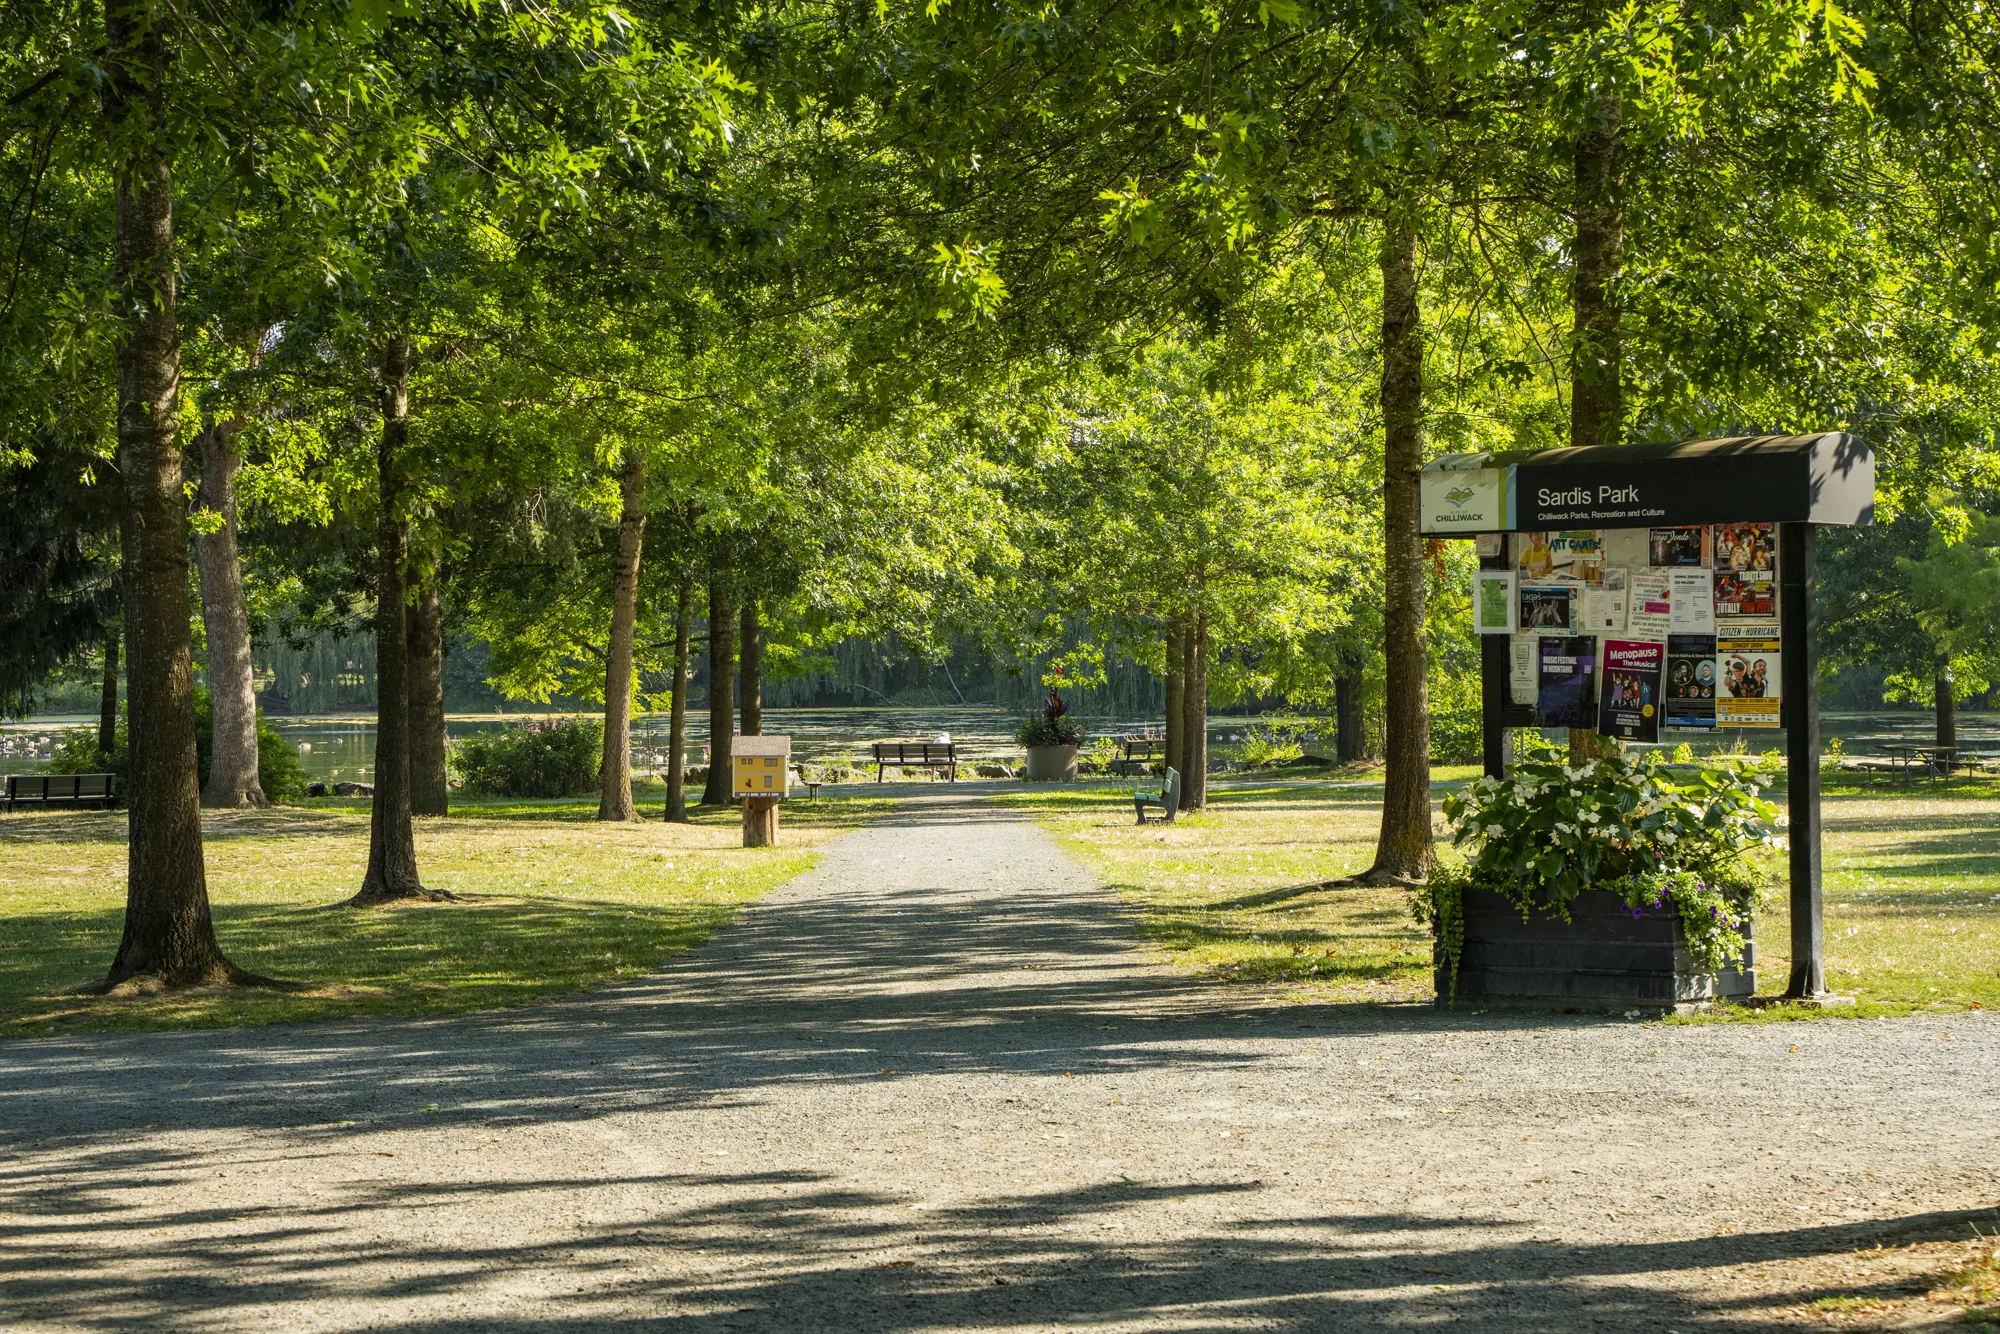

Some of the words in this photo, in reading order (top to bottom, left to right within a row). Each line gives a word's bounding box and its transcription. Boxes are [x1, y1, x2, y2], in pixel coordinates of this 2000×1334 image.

[1537, 487, 1592, 506] Sardis
[1599, 484, 1640, 504] Park
[1435, 513, 1483, 523] CHILLIWACK
[1537, 511, 1569, 521] Chilliwack
[1570, 511, 1590, 520] Parks,
[1591, 510, 1626, 519] Recreation
[1627, 509, 1640, 517] and
[1641, 508, 1665, 517] Culture
[1548, 538, 1567, 552] ART
[1716, 602, 1741, 614] TOTALLY
[1719, 628, 1742, 636] CITIZEN
[1745, 627, 1779, 636] HURRICANE
[1609, 648, 1658, 660] Menopause
[1543, 656, 1557, 664] MUSIC
[1557, 656, 1577, 665] FESTIVAL
